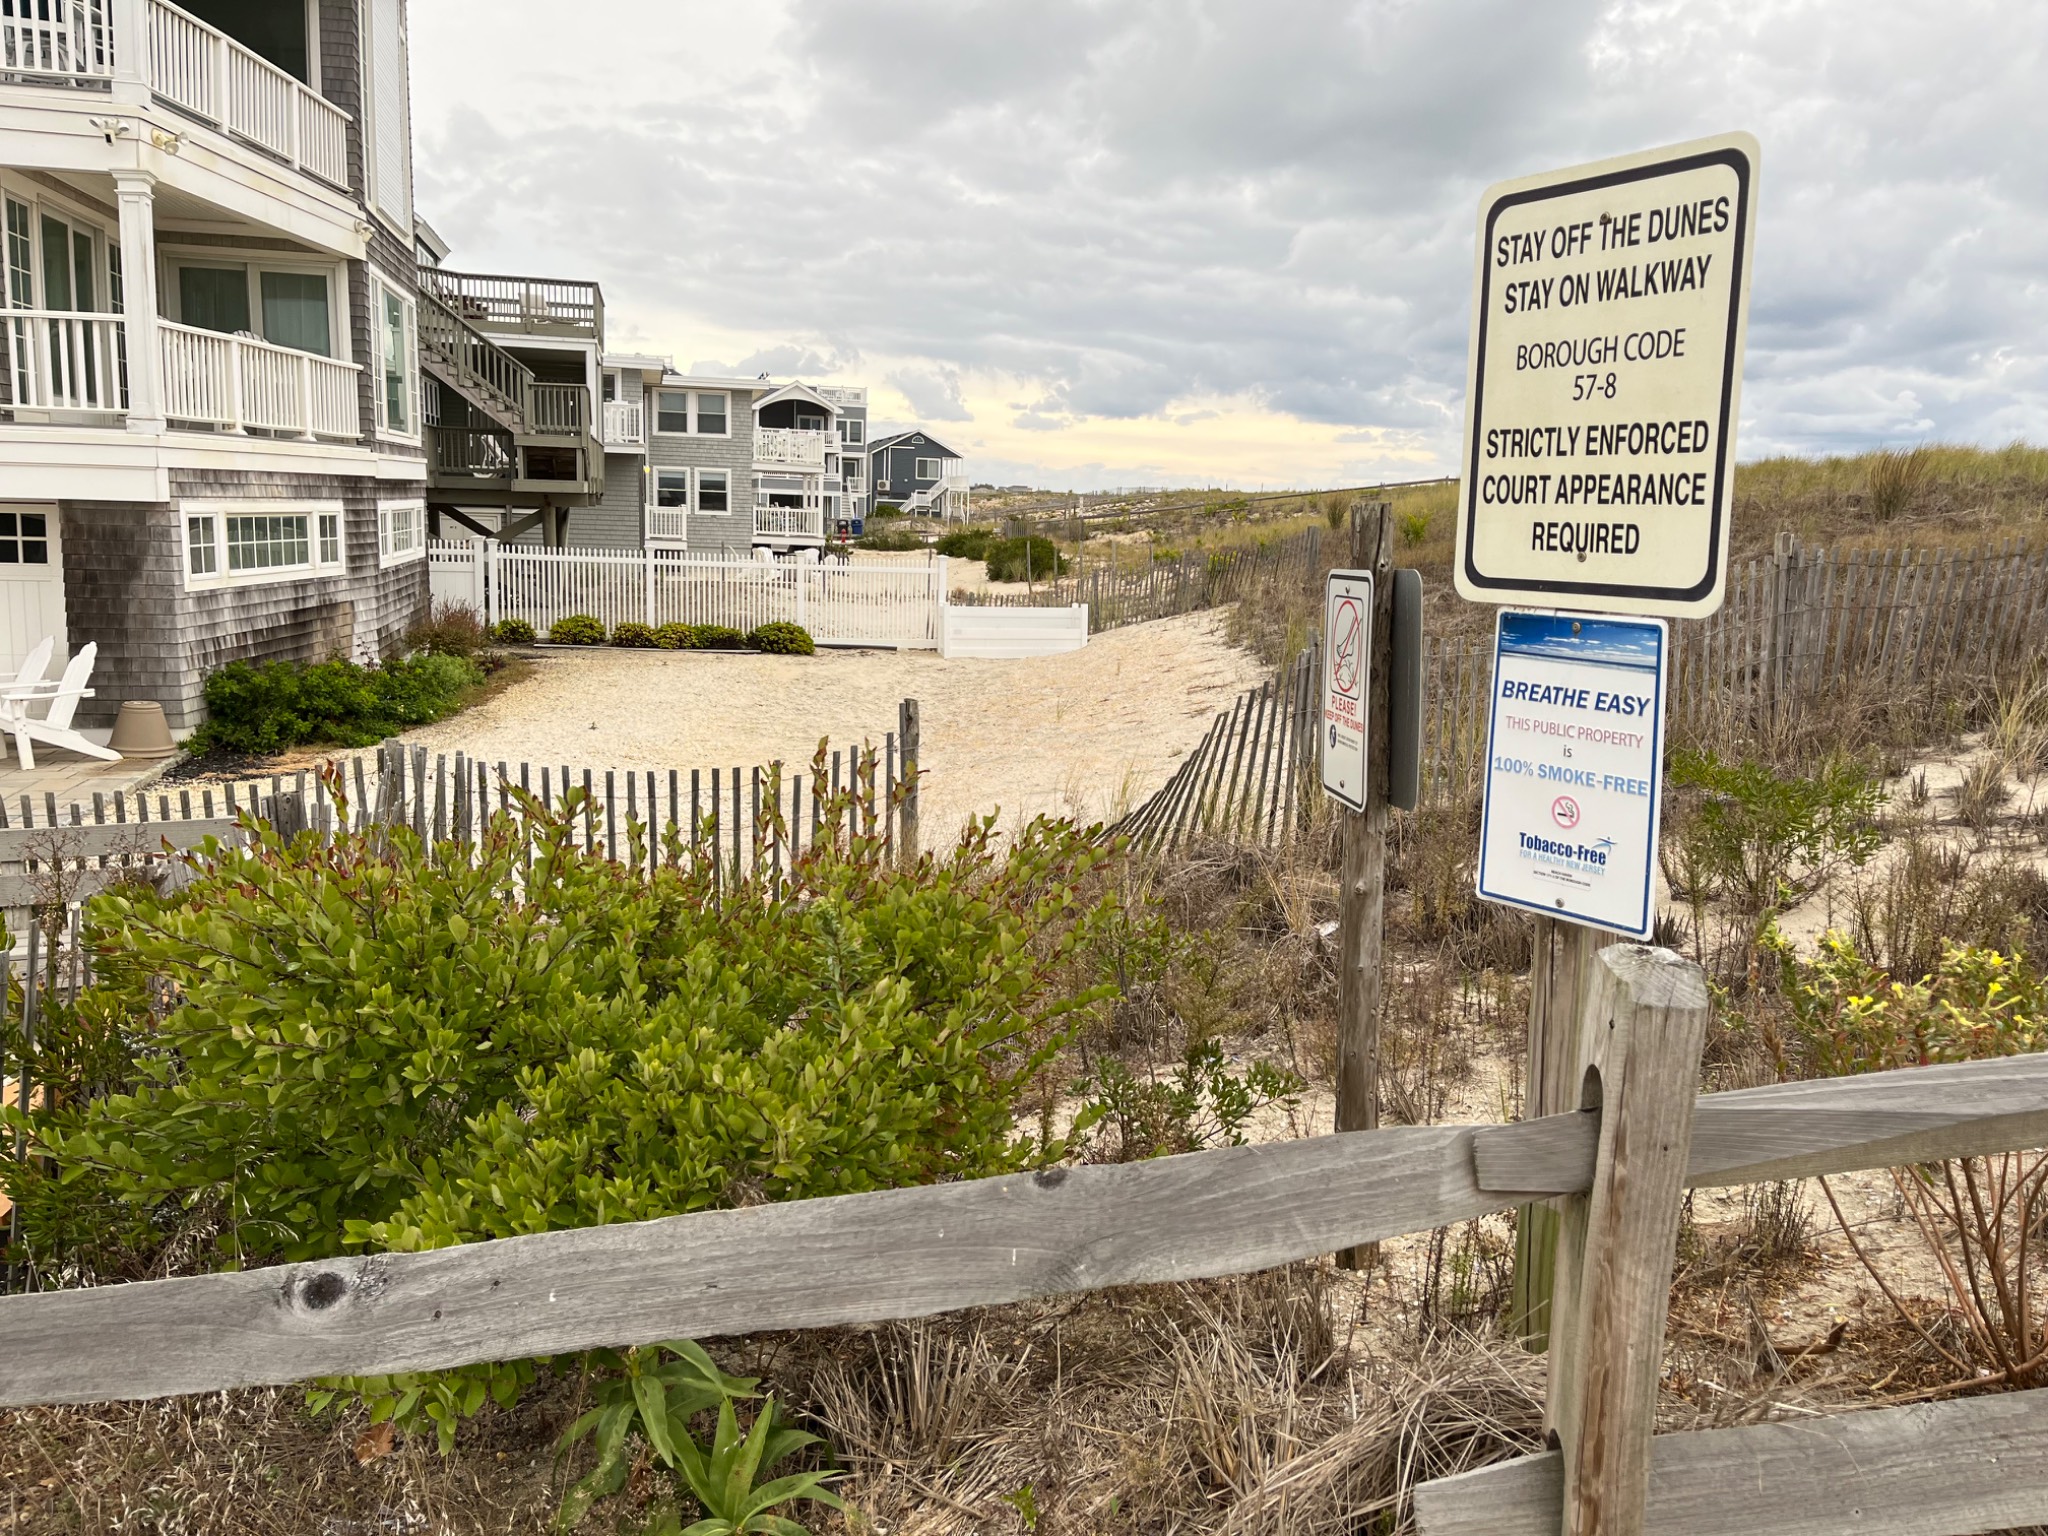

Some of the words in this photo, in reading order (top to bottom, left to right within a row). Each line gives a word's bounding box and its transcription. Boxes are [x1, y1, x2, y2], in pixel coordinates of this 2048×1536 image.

[1497, 229, 1546, 267] STAY
[1551, 221, 1593, 258] OFF
[1600, 212, 1642, 250] THE
[1648, 195, 1730, 243] DUNES
[1504, 277, 1554, 313] STAY
[1559, 272, 1590, 306] ON
[1597, 254, 1713, 302] WALKWAY
[1516, 335, 1618, 371] BOROUGH
[1624, 328, 1686, 361] CODE
[1572, 372, 1618, 402] 57-8
[1486, 426, 1581, 458] STRICTLY
[1585, 420, 1710, 456] ENFORCED
[1482, 475, 1551, 504] COURT
[1554, 473, 1707, 506] APPEARANCE
[1531, 522, 1640, 554] REQUIRED
[1332, 695, 1357, 716] PLEASE!
[1501, 680, 1591, 709] BREATHE
[1594, 691, 1652, 717] EASY
[1505, 715, 1531, 731] THIS
[1533, 719, 1576, 738] PUBLIC
[1577, 726, 1644, 749] PROPERTY
[1562, 744, 1573, 758] is
[1494, 756, 1534, 777] 100%
[1537, 763, 1650, 797] SMOKE-FREE
[1519, 831, 1606, 865] Tobacco-Free
[1520, 848, 1532, 859] FOR
[1532, 852, 1538, 860] A
[1538, 853, 1564, 867] HEALTHY
[1566, 859, 1581, 871] NEW
[1581, 863, 1606, 876] JERSEY
